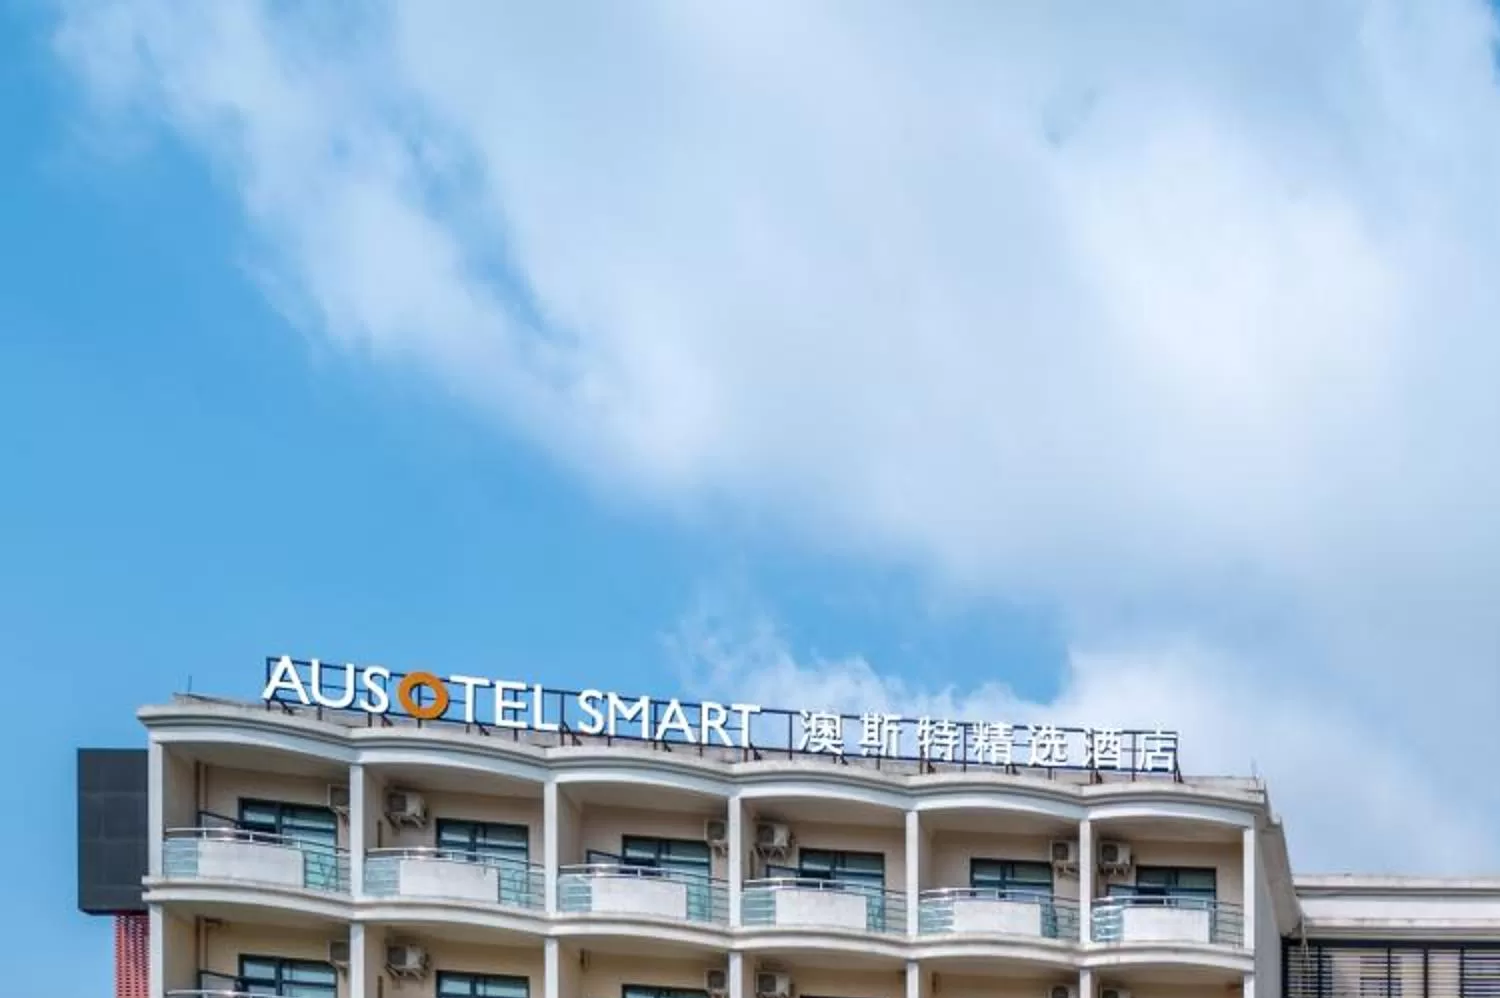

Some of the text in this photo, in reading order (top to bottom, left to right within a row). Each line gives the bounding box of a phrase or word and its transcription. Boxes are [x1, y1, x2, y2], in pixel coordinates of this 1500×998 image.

[262, 655, 761, 748] AUSOTEL SMART
[800, 709, 1178, 772] 澳斯特精选酒店
